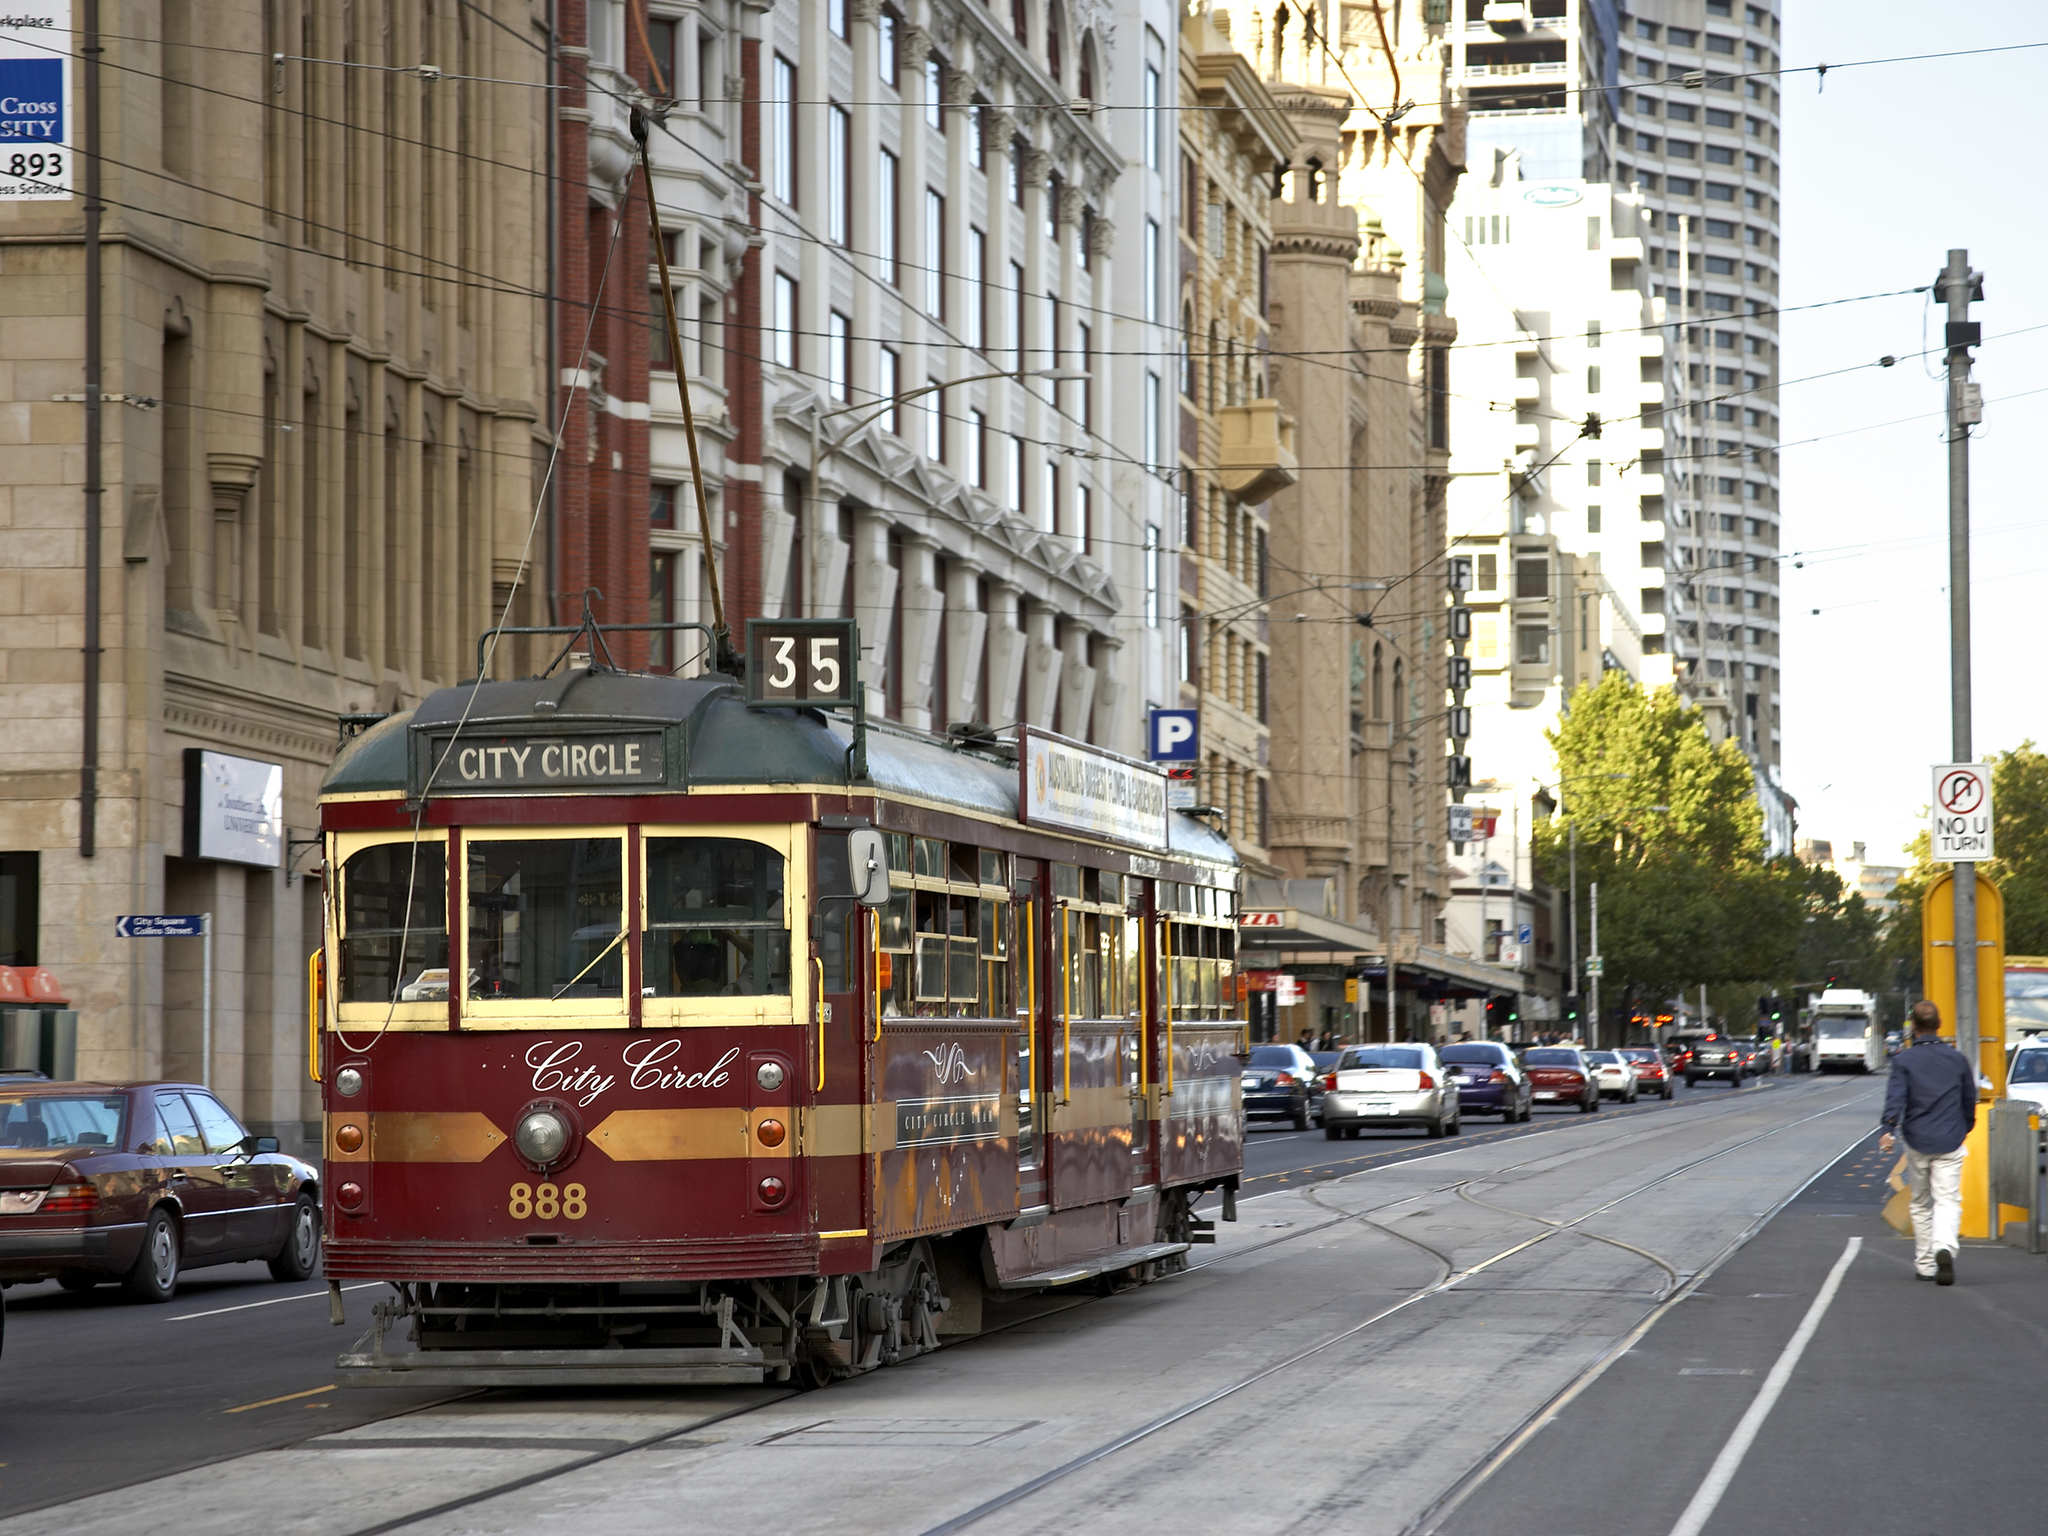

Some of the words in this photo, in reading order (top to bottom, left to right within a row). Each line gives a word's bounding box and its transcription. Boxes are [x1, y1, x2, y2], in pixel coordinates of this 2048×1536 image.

[0, 97, 57, 114] Cross
[10, 153, 63, 176] 893
[19, 182, 64, 195] School
[768, 636, 841, 693] 35
[1452, 556, 1472, 788] FORUM
[1158, 716, 1194, 754] P
[458, 746, 532, 781] CITY
[541, 743, 642, 777] CIRCLE
[1937, 817, 1967, 835] NO
[1973, 816, 1988, 834] U
[1941, 836, 1985, 851] TURN
[133, 917, 153, 927] City
[164, 926, 194, 935] Street
[525, 1040, 616, 1107] City
[622, 1038, 740, 1090] Circle
[904, 1114, 927, 1130] CITY
[933, 1111, 965, 1128] CIRCLE
[508, 1182, 588, 1220] 888
